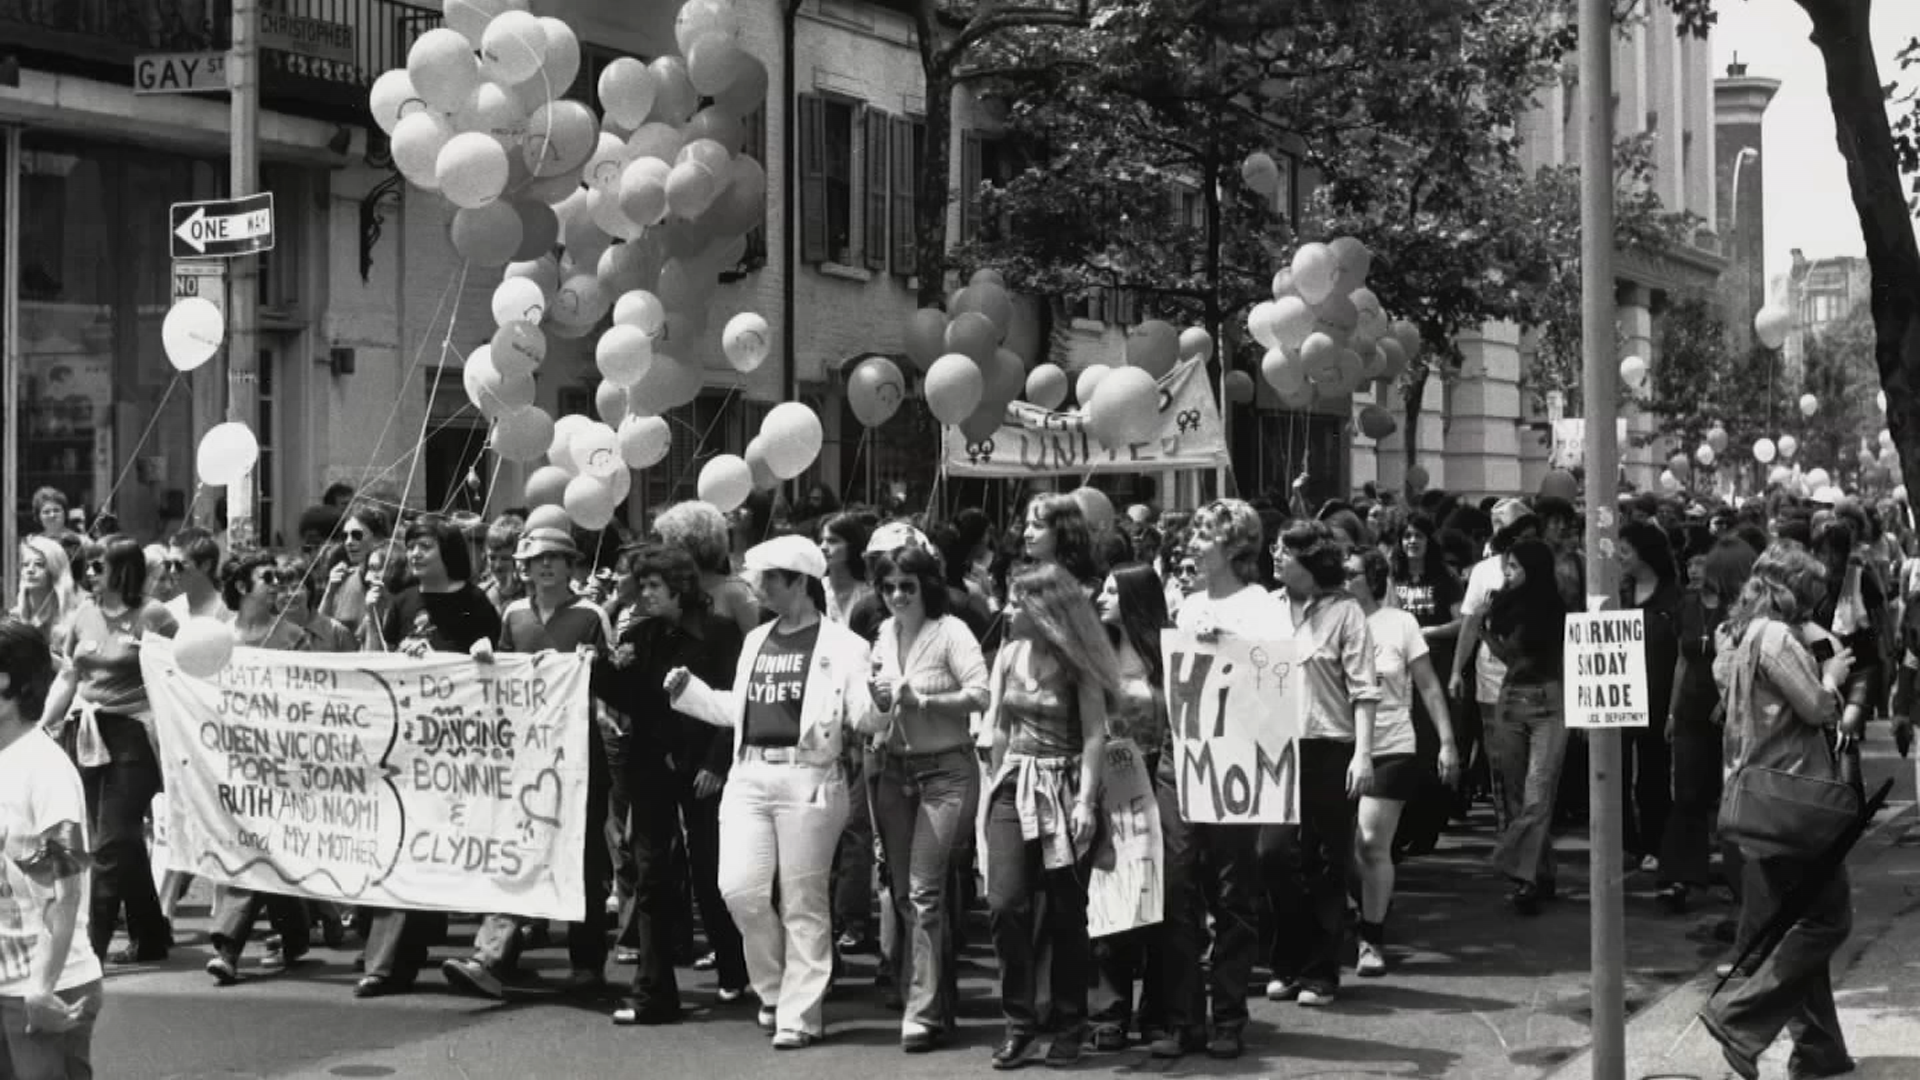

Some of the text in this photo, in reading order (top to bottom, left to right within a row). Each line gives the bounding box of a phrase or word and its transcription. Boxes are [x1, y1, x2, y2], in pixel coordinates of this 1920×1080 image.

[260, 13, 352, 48] CHRISTOPHER
[138, 58, 223, 88] GAY ST
[191, 219, 230, 239] ONE
[174, 277, 197, 295] NO
[1569, 619, 1643, 644] NO RKING
[286, 666, 337, 689] HARI
[755, 654, 804, 673] ONNIE
[420, 674, 547, 708] DO THEIR
[748, 682, 802, 704] LYDE'S
[1170, 652, 1232, 740] Hi
[217, 690, 371, 728] JOAN OF ARC
[200, 721, 371, 765] QUEEN VICTORIA
[416, 714, 553, 750] DANCING AT
[228, 755, 366, 794] POPE JOAN
[414, 758, 512, 800] BONNIE
[218, 784, 273, 817] RUTH
[278, 790, 317, 822] AND
[238, 824, 381, 868] and MY MOTHER
[409, 831, 522, 875] CLYDES
